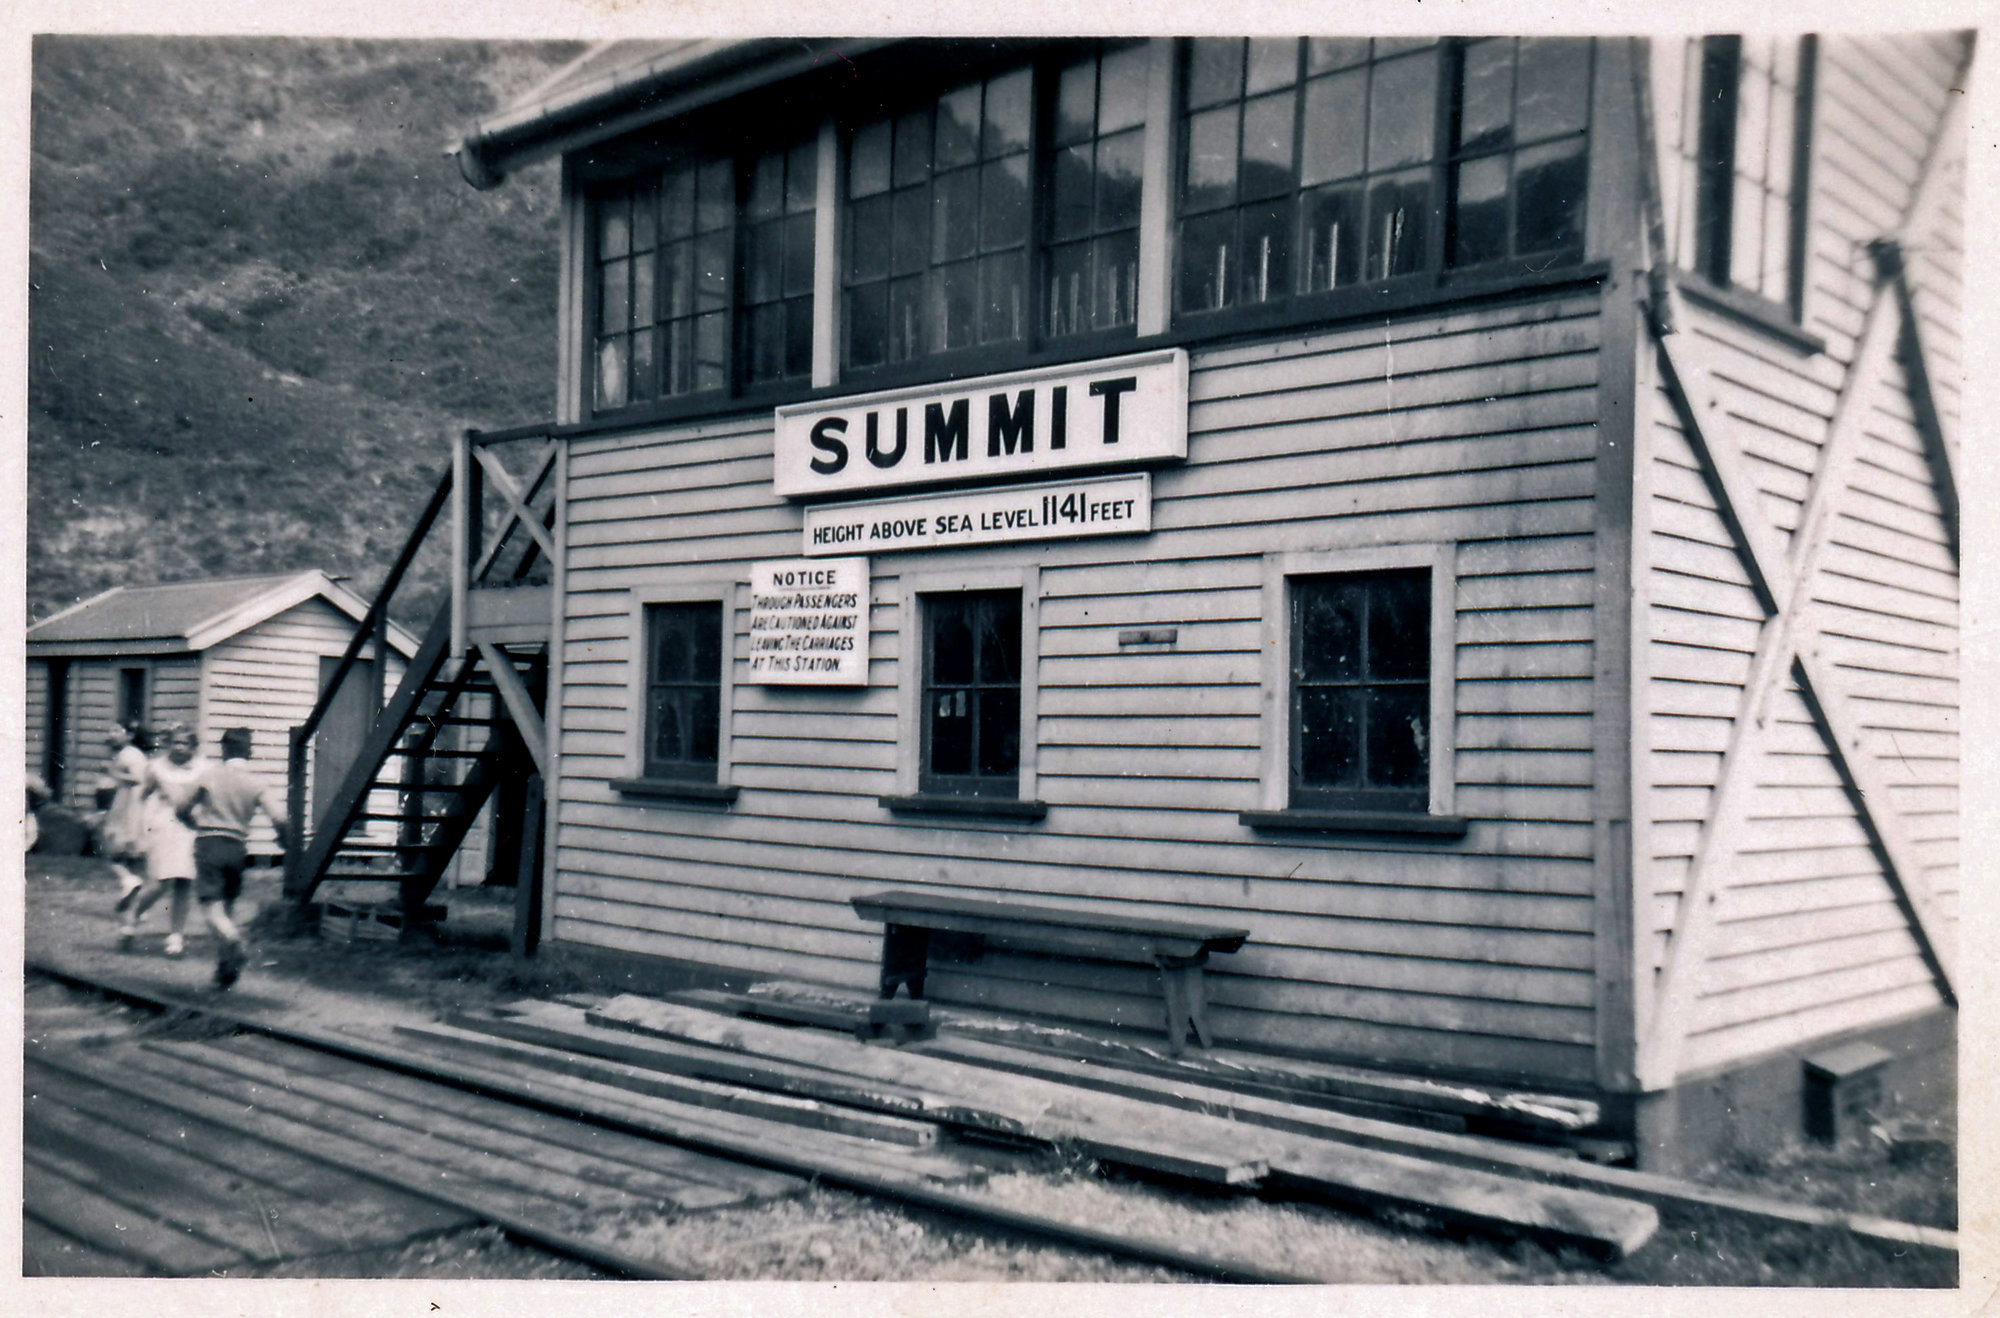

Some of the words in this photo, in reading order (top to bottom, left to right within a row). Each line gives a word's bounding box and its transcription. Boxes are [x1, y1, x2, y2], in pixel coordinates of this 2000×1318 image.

[810, 376, 1137, 475] SUMMIT
[813, 524, 864, 545] HEIGHT
[870, 518, 927, 540] ABOVE
[935, 514, 973, 535] SEA
[981, 508, 1039, 531] LEVEL
[1042, 492, 1086, 526] 1141
[1090, 500, 1134, 522] FEET
[773, 570, 836, 586] NOTICE
[794, 593, 857, 609] PASSENGERS
[820, 613, 857, 630] AGAINST
[802, 634, 854, 651] CARRIAGES
[752, 656, 765, 670] AT
[768, 655, 791, 671] THIS
[794, 655, 840, 672] STATION
